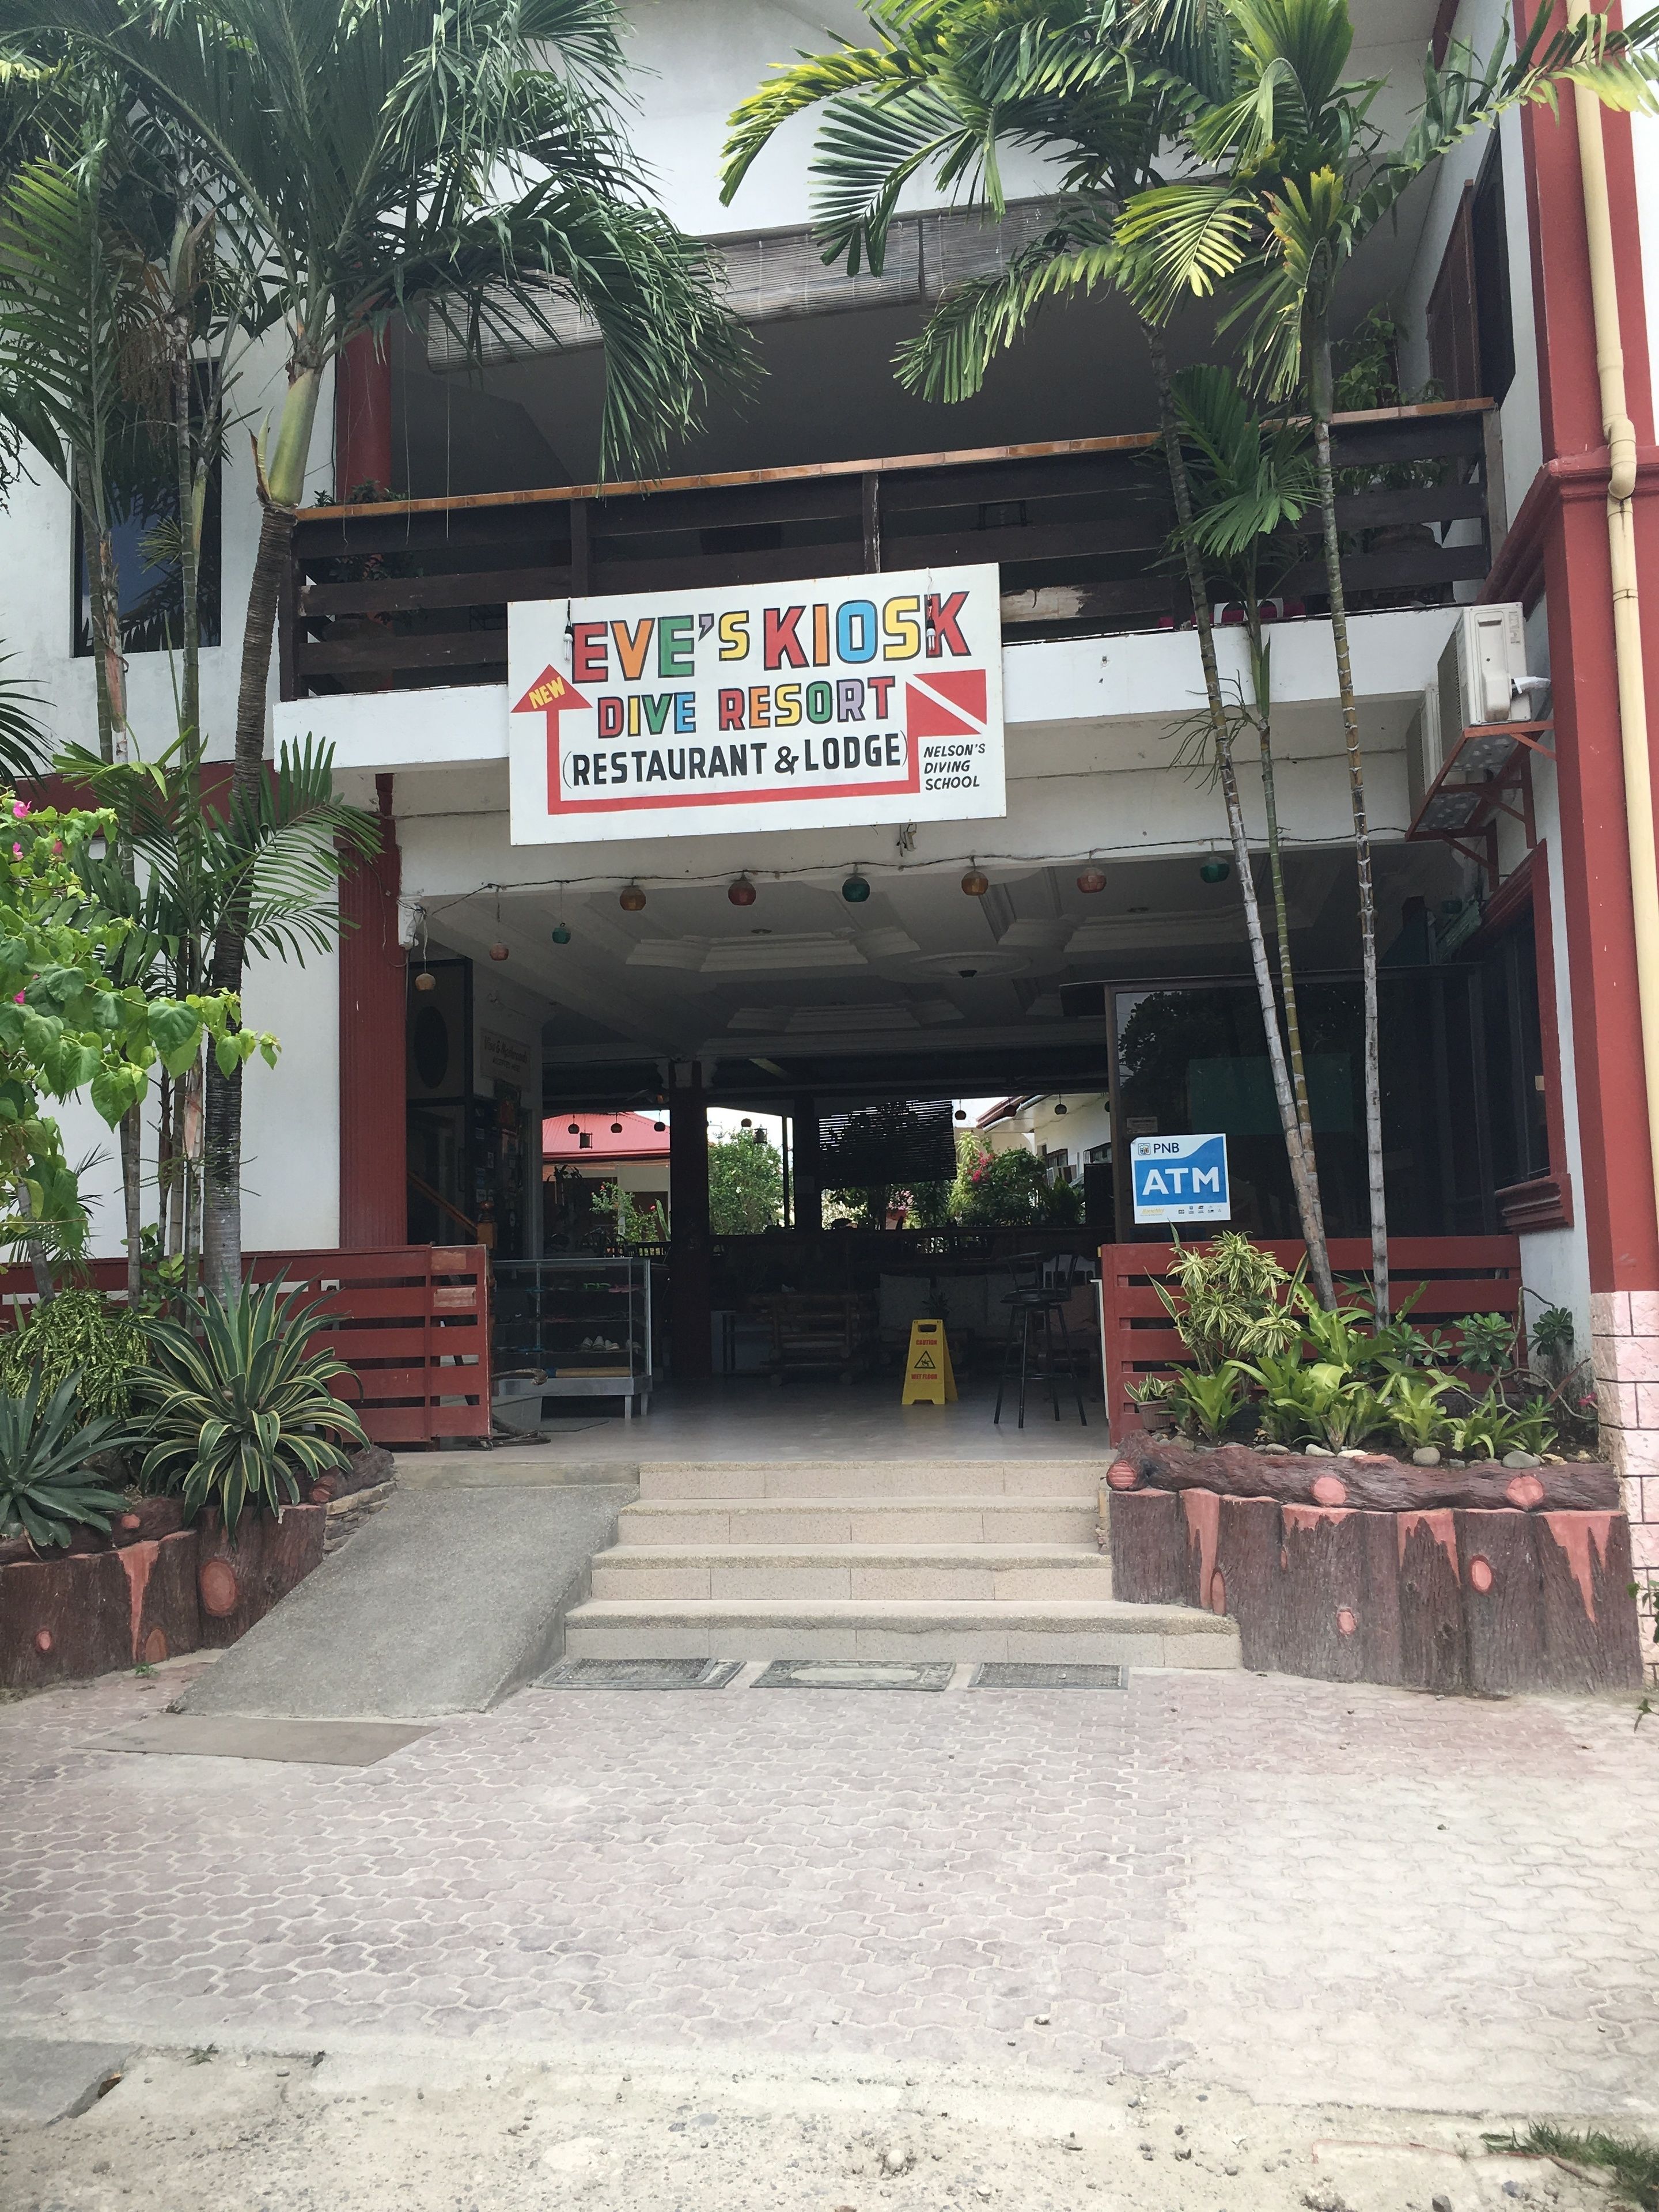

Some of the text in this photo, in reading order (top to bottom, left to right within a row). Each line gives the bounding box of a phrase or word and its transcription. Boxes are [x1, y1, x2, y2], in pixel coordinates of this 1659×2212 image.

[572, 590, 972, 684] EVE'S KIOSK
[528, 677, 567, 710] NEW
[597, 675, 896, 738] DIVE RESORT
[774, 745, 800, 775] &
[923, 743, 986, 757] NELSON'S
[923, 760, 971, 774] DIVING
[925, 775, 980, 791] SCHOOL
[1153, 1142, 1180, 1154] PNB
[1142, 1166, 1220, 1196] ATM
